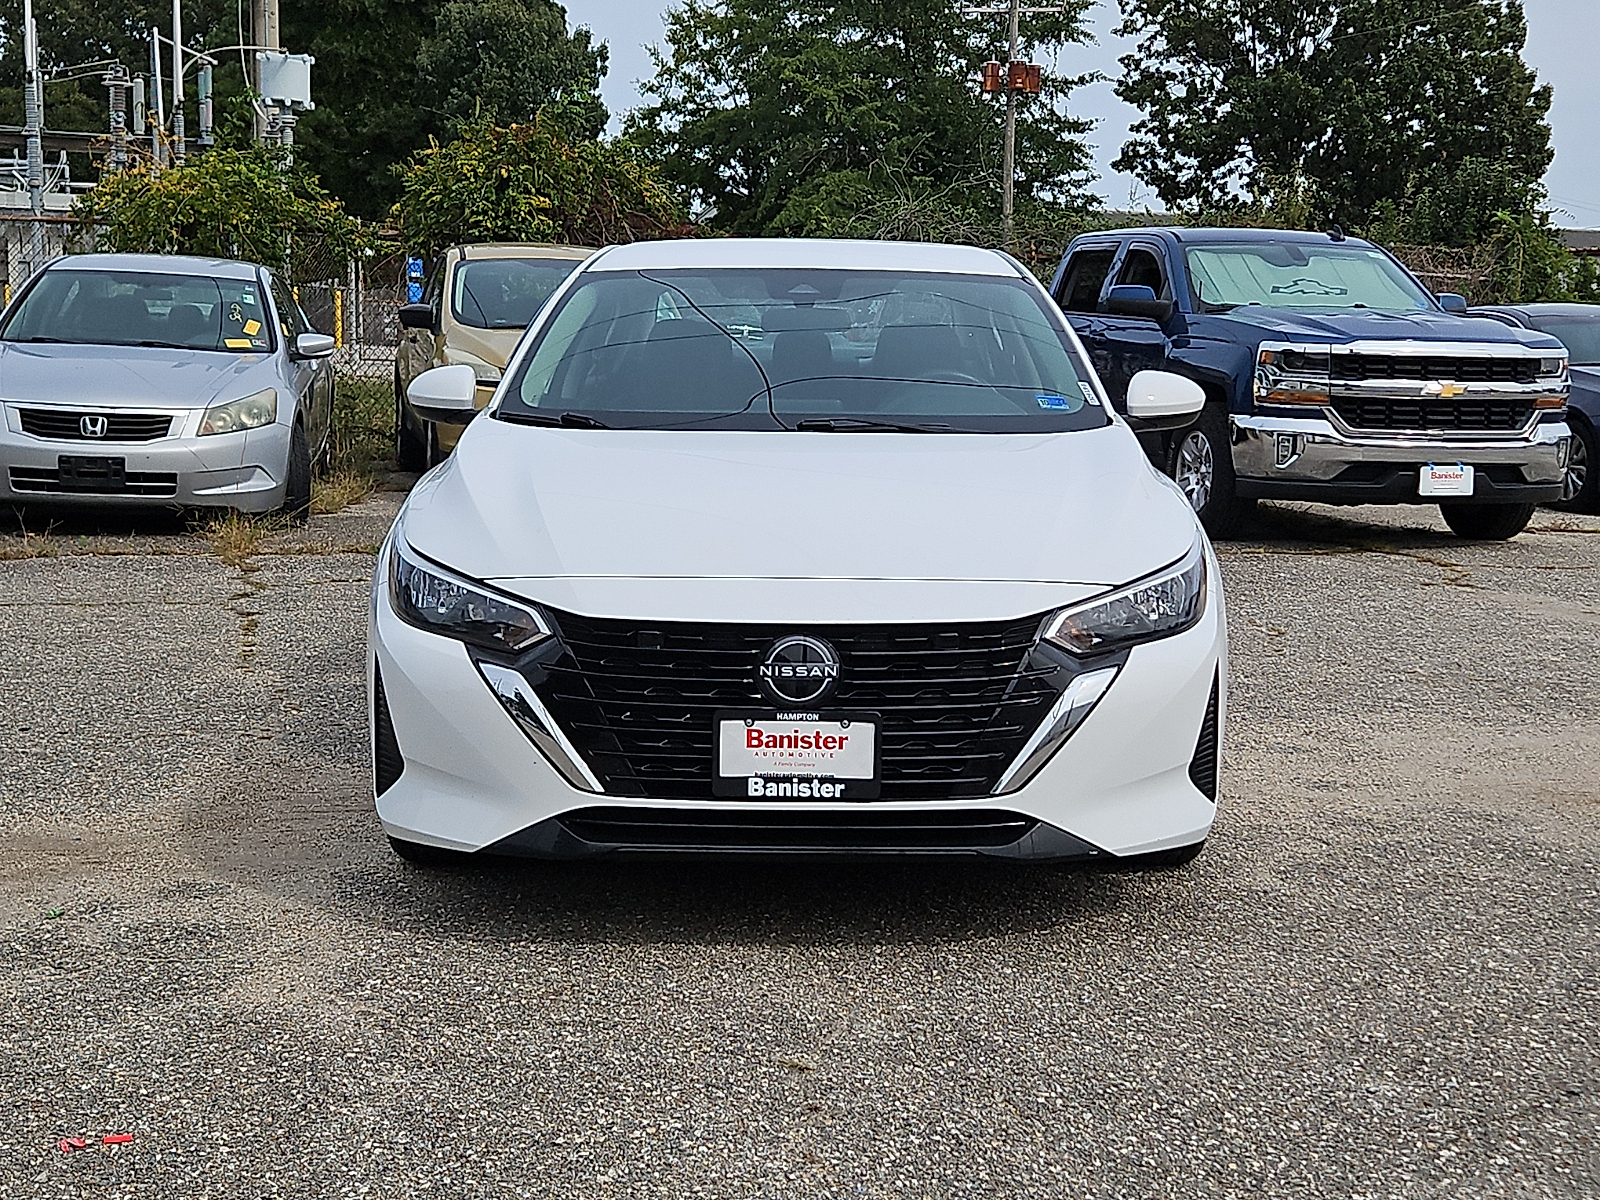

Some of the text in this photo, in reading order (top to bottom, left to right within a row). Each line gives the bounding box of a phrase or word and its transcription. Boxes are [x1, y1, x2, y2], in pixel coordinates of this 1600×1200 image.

[1430, 471, 1464, 480] Banister
[760, 665, 837, 677] NISSAN
[776, 712, 819, 721] HAMPTON
[745, 728, 849, 750] Banister
[754, 751, 835, 759] AUTOMOTIVE
[747, 777, 846, 798] Banister
